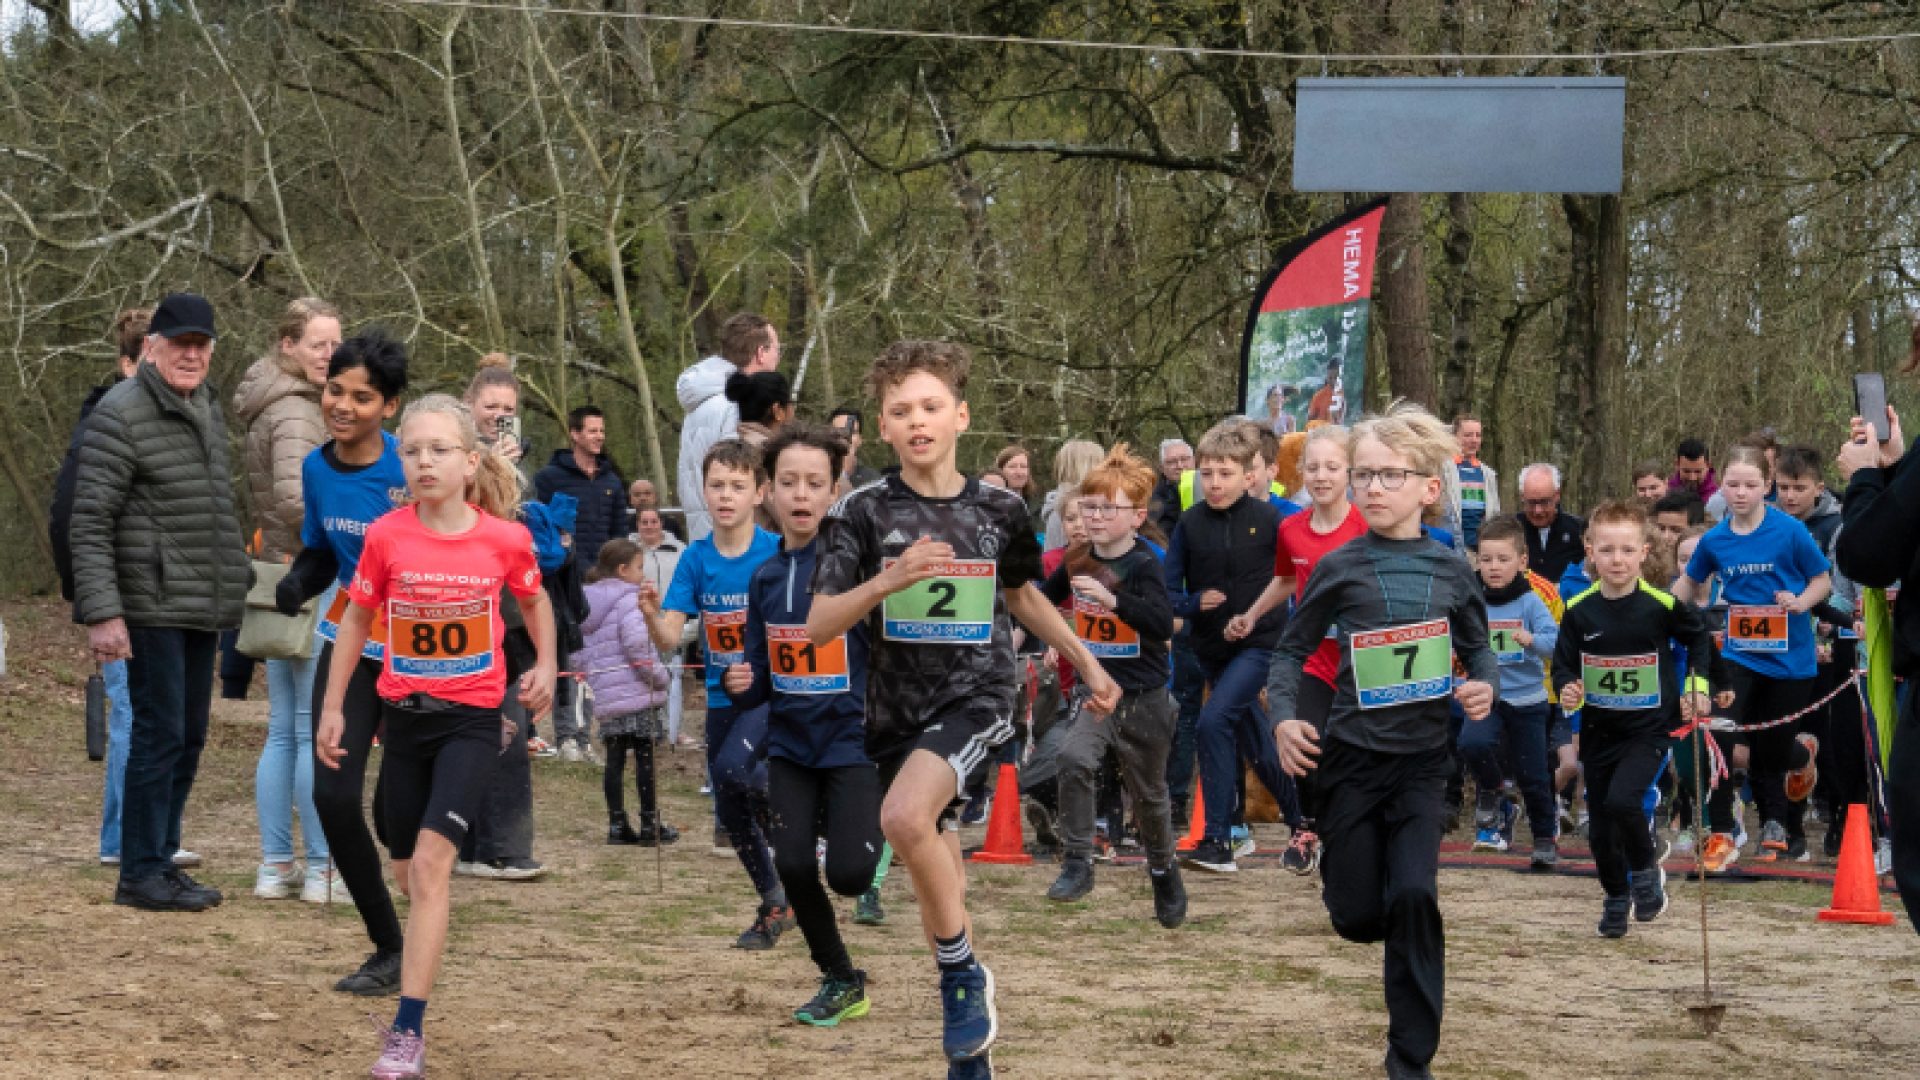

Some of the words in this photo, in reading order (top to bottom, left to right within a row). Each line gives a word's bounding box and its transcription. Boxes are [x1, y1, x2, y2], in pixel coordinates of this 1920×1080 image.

[1343, 228, 1364, 298] HEMA
[926, 582, 957, 618] 2
[411, 623, 469, 656] 80
[1083, 614, 1117, 642] 79
[1739, 617, 1771, 638] 64
[778, 643, 817, 674] 61
[1393, 645, 1419, 680] 7
[1597, 670, 1640, 694] 45
